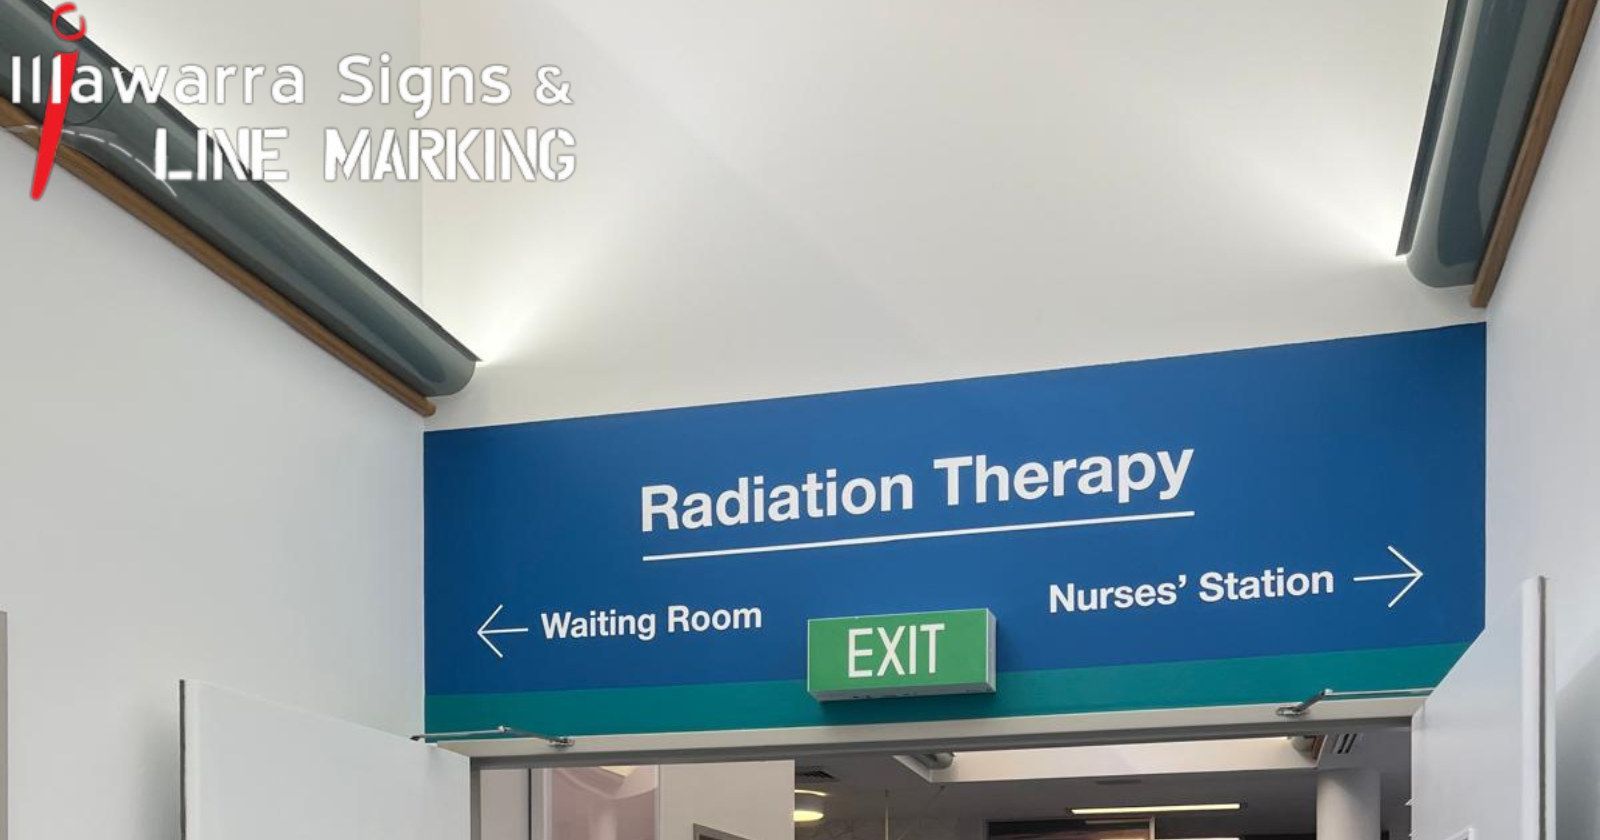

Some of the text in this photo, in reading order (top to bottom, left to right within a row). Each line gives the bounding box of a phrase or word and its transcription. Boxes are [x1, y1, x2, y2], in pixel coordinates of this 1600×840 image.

[641, 448, 1194, 532] Radiation Therapy
[1198, 567, 1334, 602] Station
[540, 605, 762, 641] Waiting Room
[847, 623, 945, 678] EXIT
